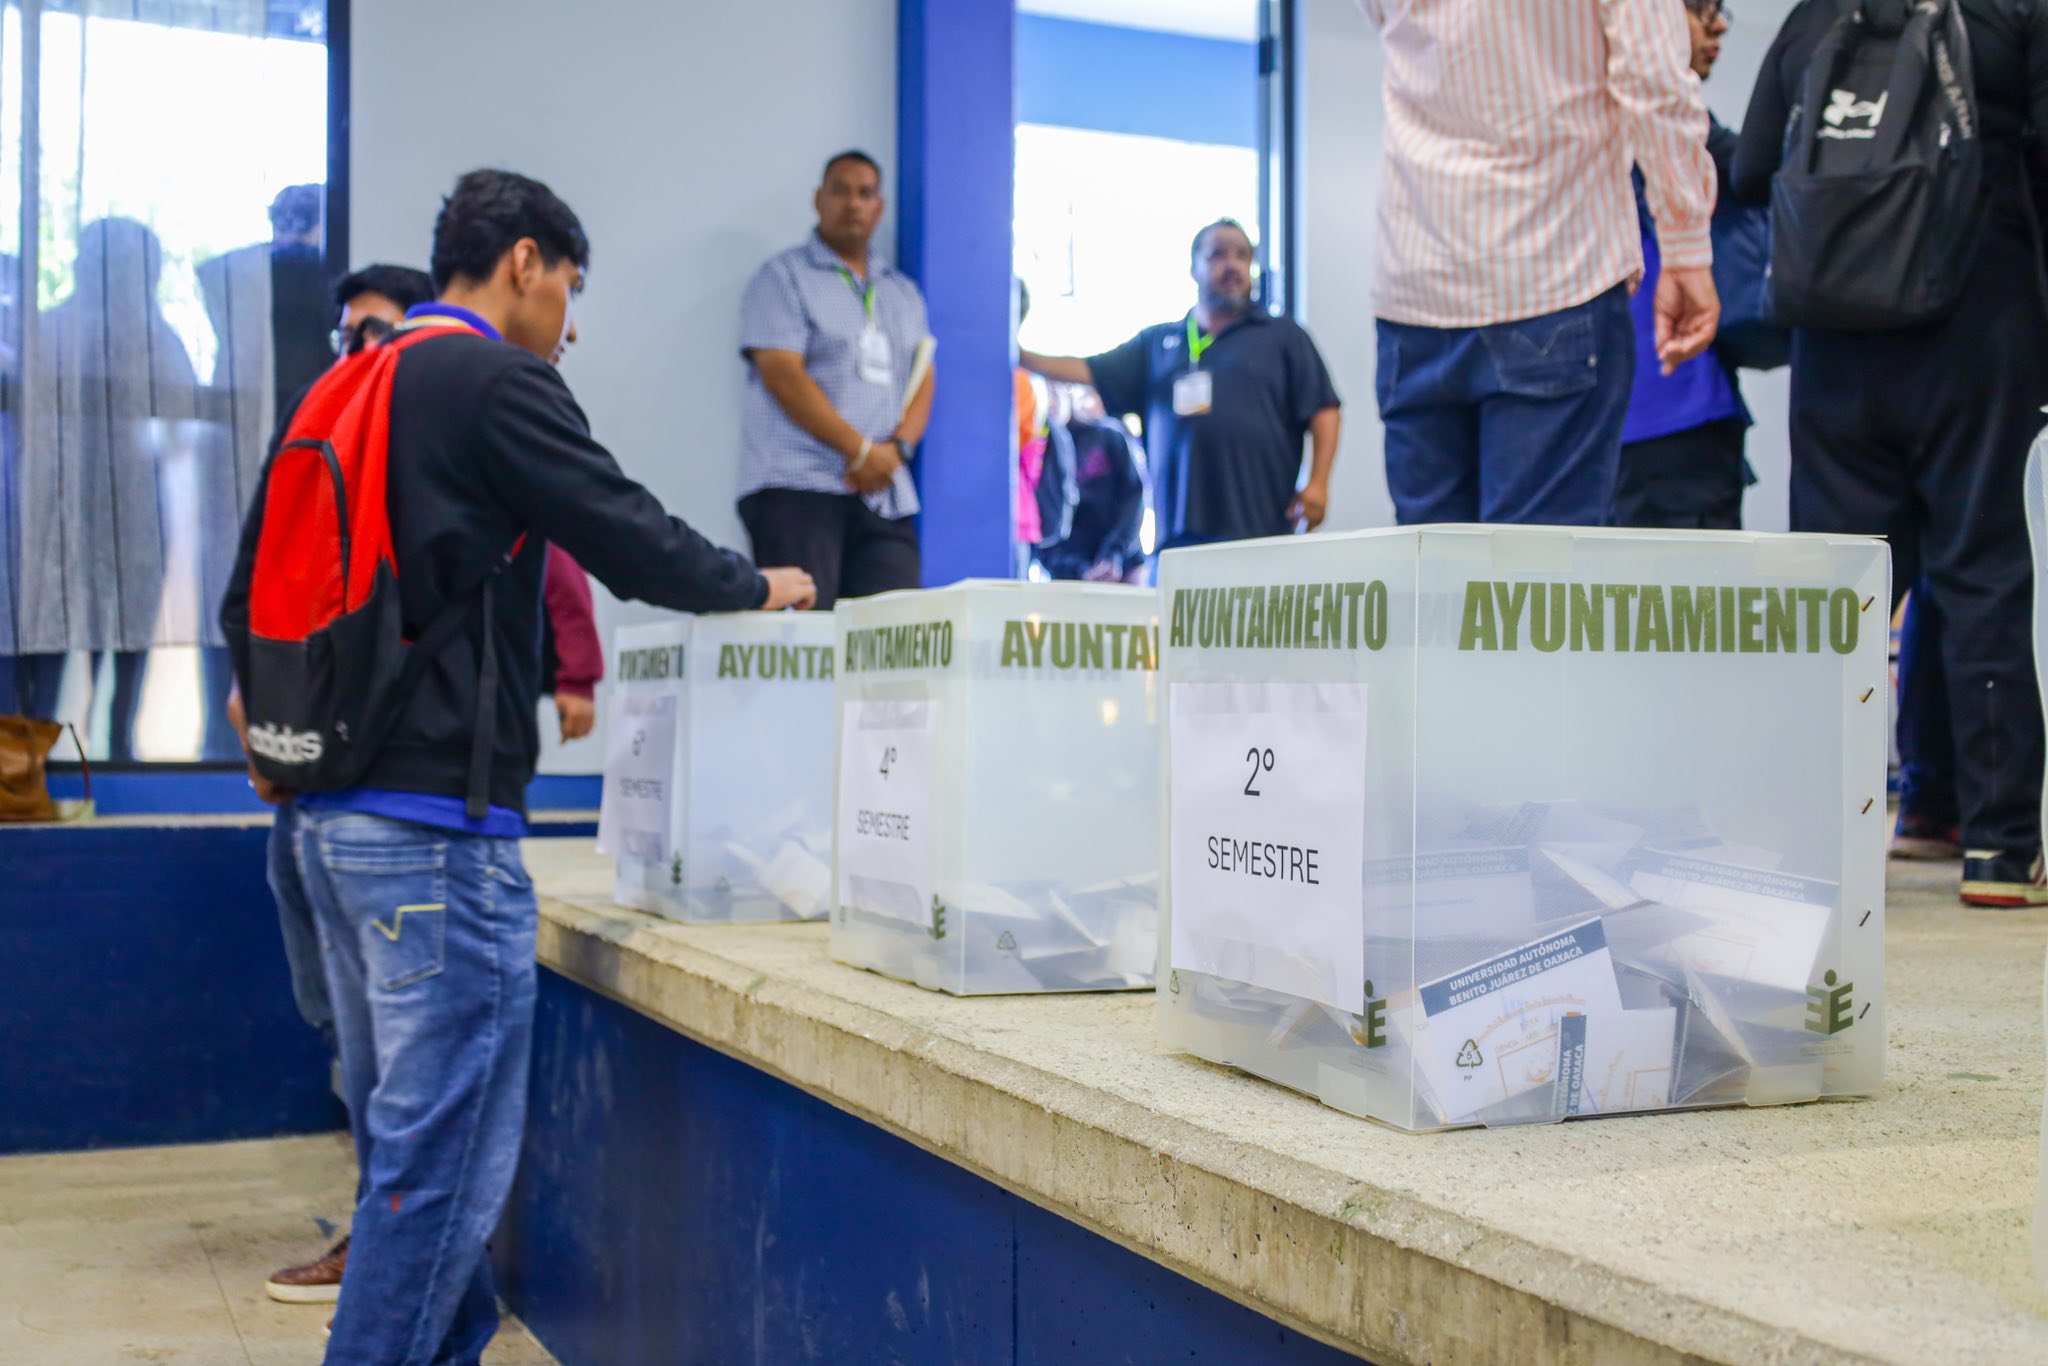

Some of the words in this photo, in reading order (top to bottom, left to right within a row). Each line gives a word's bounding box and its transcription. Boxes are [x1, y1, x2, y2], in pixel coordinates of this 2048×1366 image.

[1170, 580, 1387, 651] AYUNTAMIENTO
[1458, 581, 1860, 654] AYUNTAMIENTO
[845, 620, 953, 672] AYUNTAMIENTO
[857, 810, 910, 841] SEMESTRE
[1208, 836, 1319, 884] SEMESTRE
[1449, 985, 1487, 1006] BENITO
[1489, 970, 1528, 993] JUÁREZ
[1529, 963, 1543, 975] DE
[1543, 946, 1583, 968] OAXACA
[1450, 958, 1517, 991] UNIVERSIDAD
[1518, 934, 1576, 964] AUTÓNOMA
[1466, 1051, 1473, 1060] 5
[1571, 1044, 1584, 1090] OAXACA
